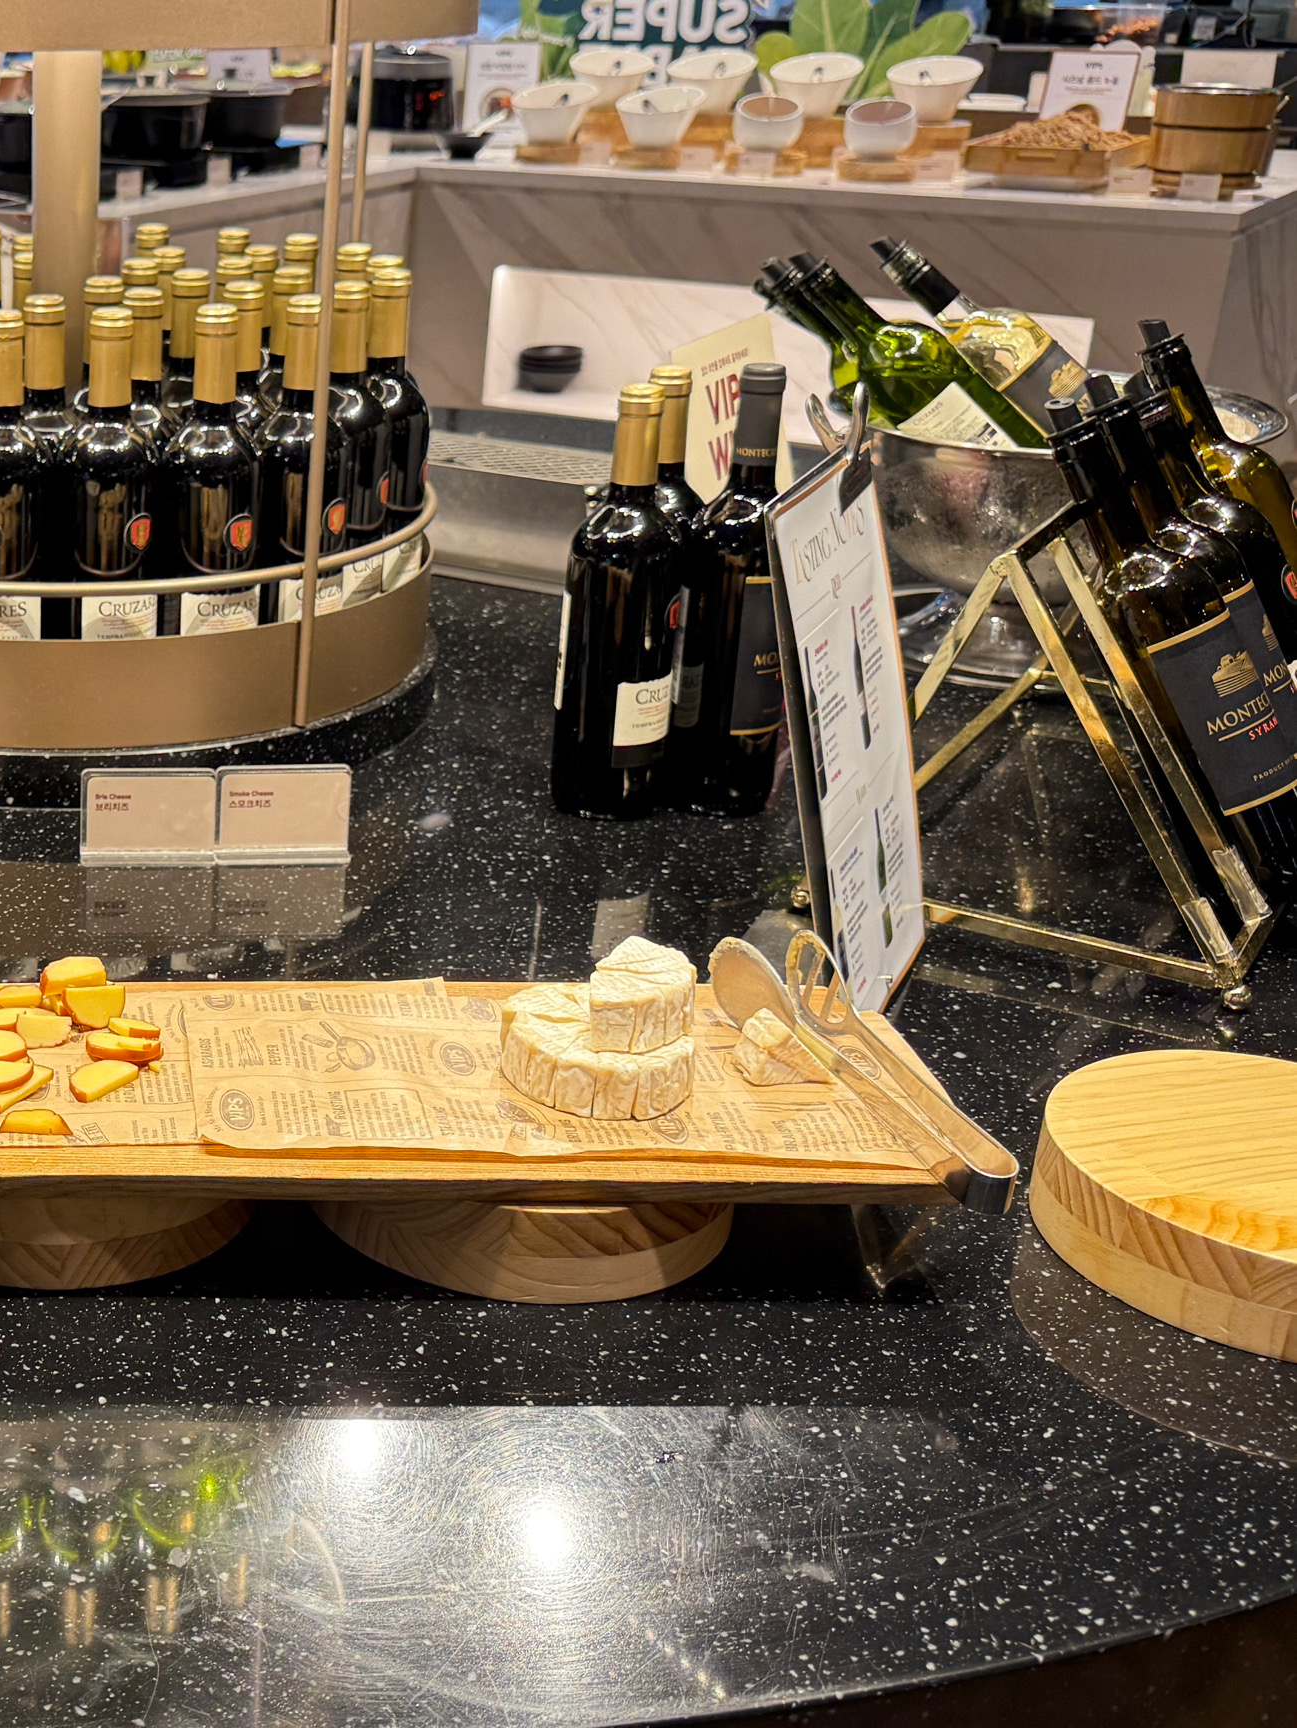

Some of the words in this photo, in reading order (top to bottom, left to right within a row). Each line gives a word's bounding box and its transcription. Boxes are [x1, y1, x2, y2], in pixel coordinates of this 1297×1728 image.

[1253, 762, 1284, 782] PRODUCT
[95, 802, 129, 812] 브리치즈
[228, 799, 271, 809] 스모크치즈
[199, 1038, 215, 1068] ASPARAGUS
[266, 1044, 282, 1066] PEPPER
[447, 1049, 468, 1073] VIPS
[847, 1051, 873, 1074] VIPS
[229, 1097, 246, 1121] VIPS
[328, 1091, 346, 1120] ROASTING
[772, 1120, 799, 1152] BRAISING
